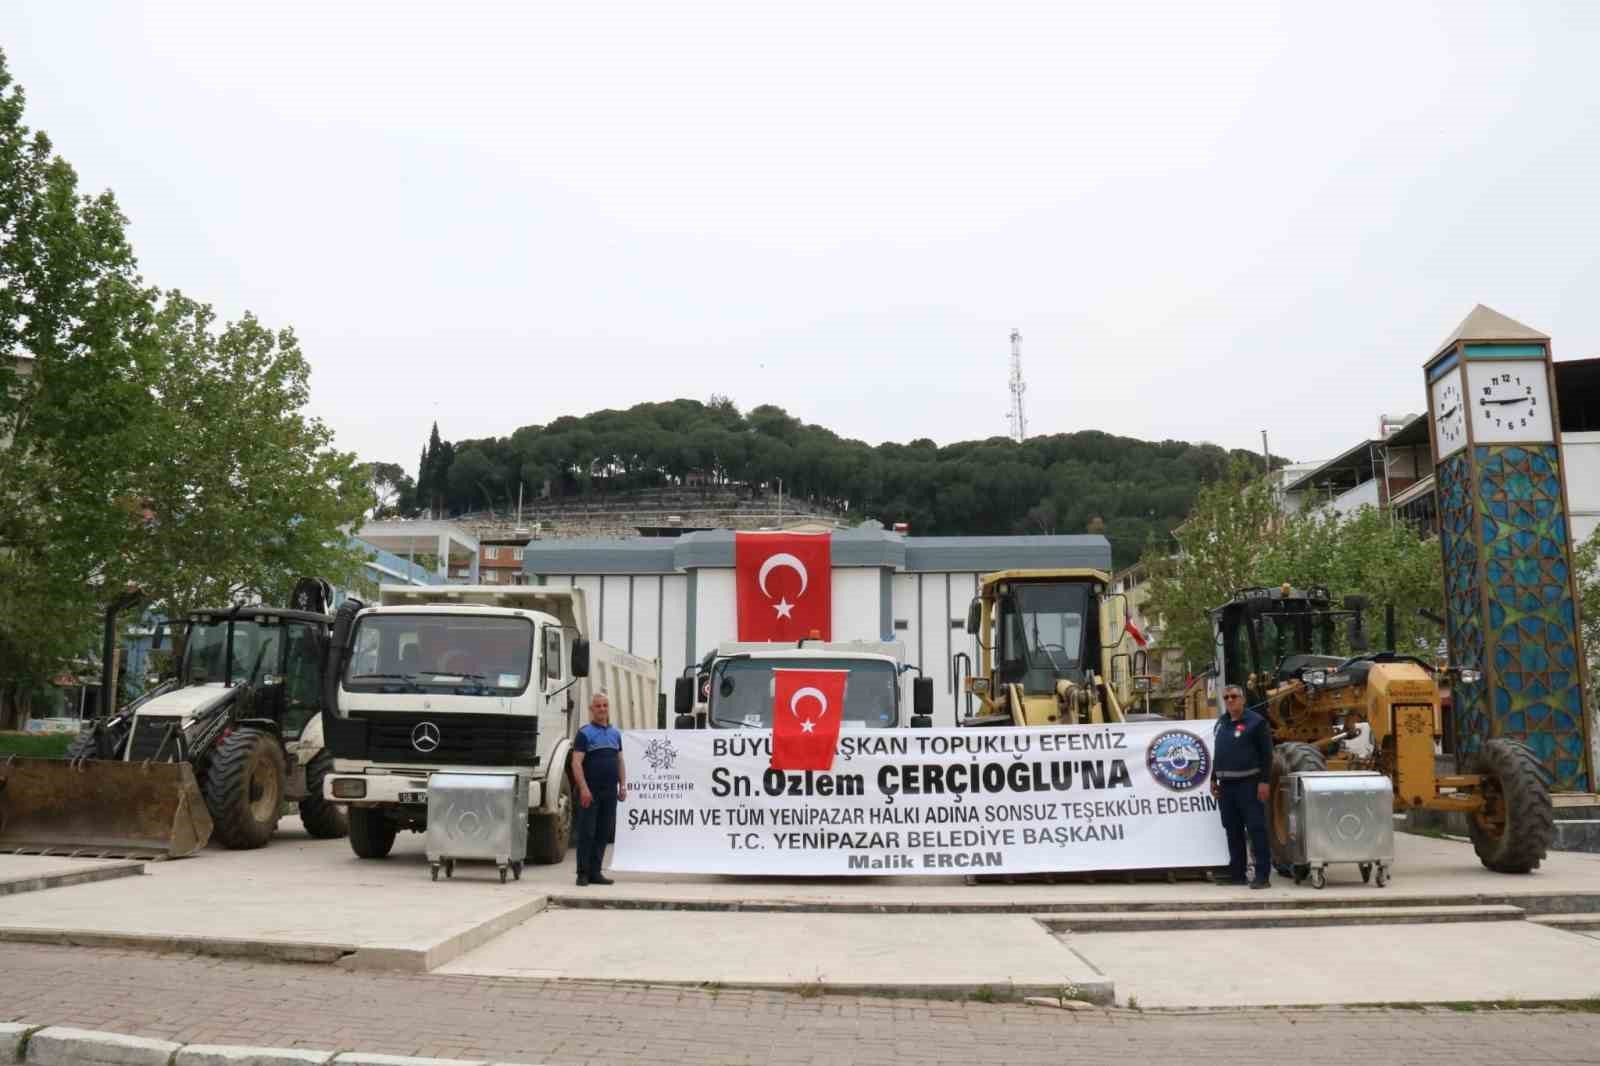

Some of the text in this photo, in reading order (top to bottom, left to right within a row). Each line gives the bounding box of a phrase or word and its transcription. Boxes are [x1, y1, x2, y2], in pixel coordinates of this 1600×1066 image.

[1501, 374, 1511, 382] 12
[713, 733, 773, 757] BÜY
[916, 735, 1031, 755] TOPUKLU
[1040, 728, 1127, 752] EFEMİZ
[877, 753, 1133, 804] ÇERÇİOĞLU'NA
[628, 808, 694, 831] ŞAHSIM
[700, 808, 721, 826] VE
[726, 803, 765, 826] TÜM
[770, 803, 865, 826] YENİPAZAR
[870, 806, 920, 825] HALKI
[925, 805, 980, 823] ADINA
[985, 803, 1057, 823] SONSUZ
[1061, 794, 1153, 823] TEŞEKKÜR
[727, 823, 1125, 850] T.C. YENİPAZAR BELEDİYE BAŞKANI
[848, 852, 1004, 869] Malik ERCAN
